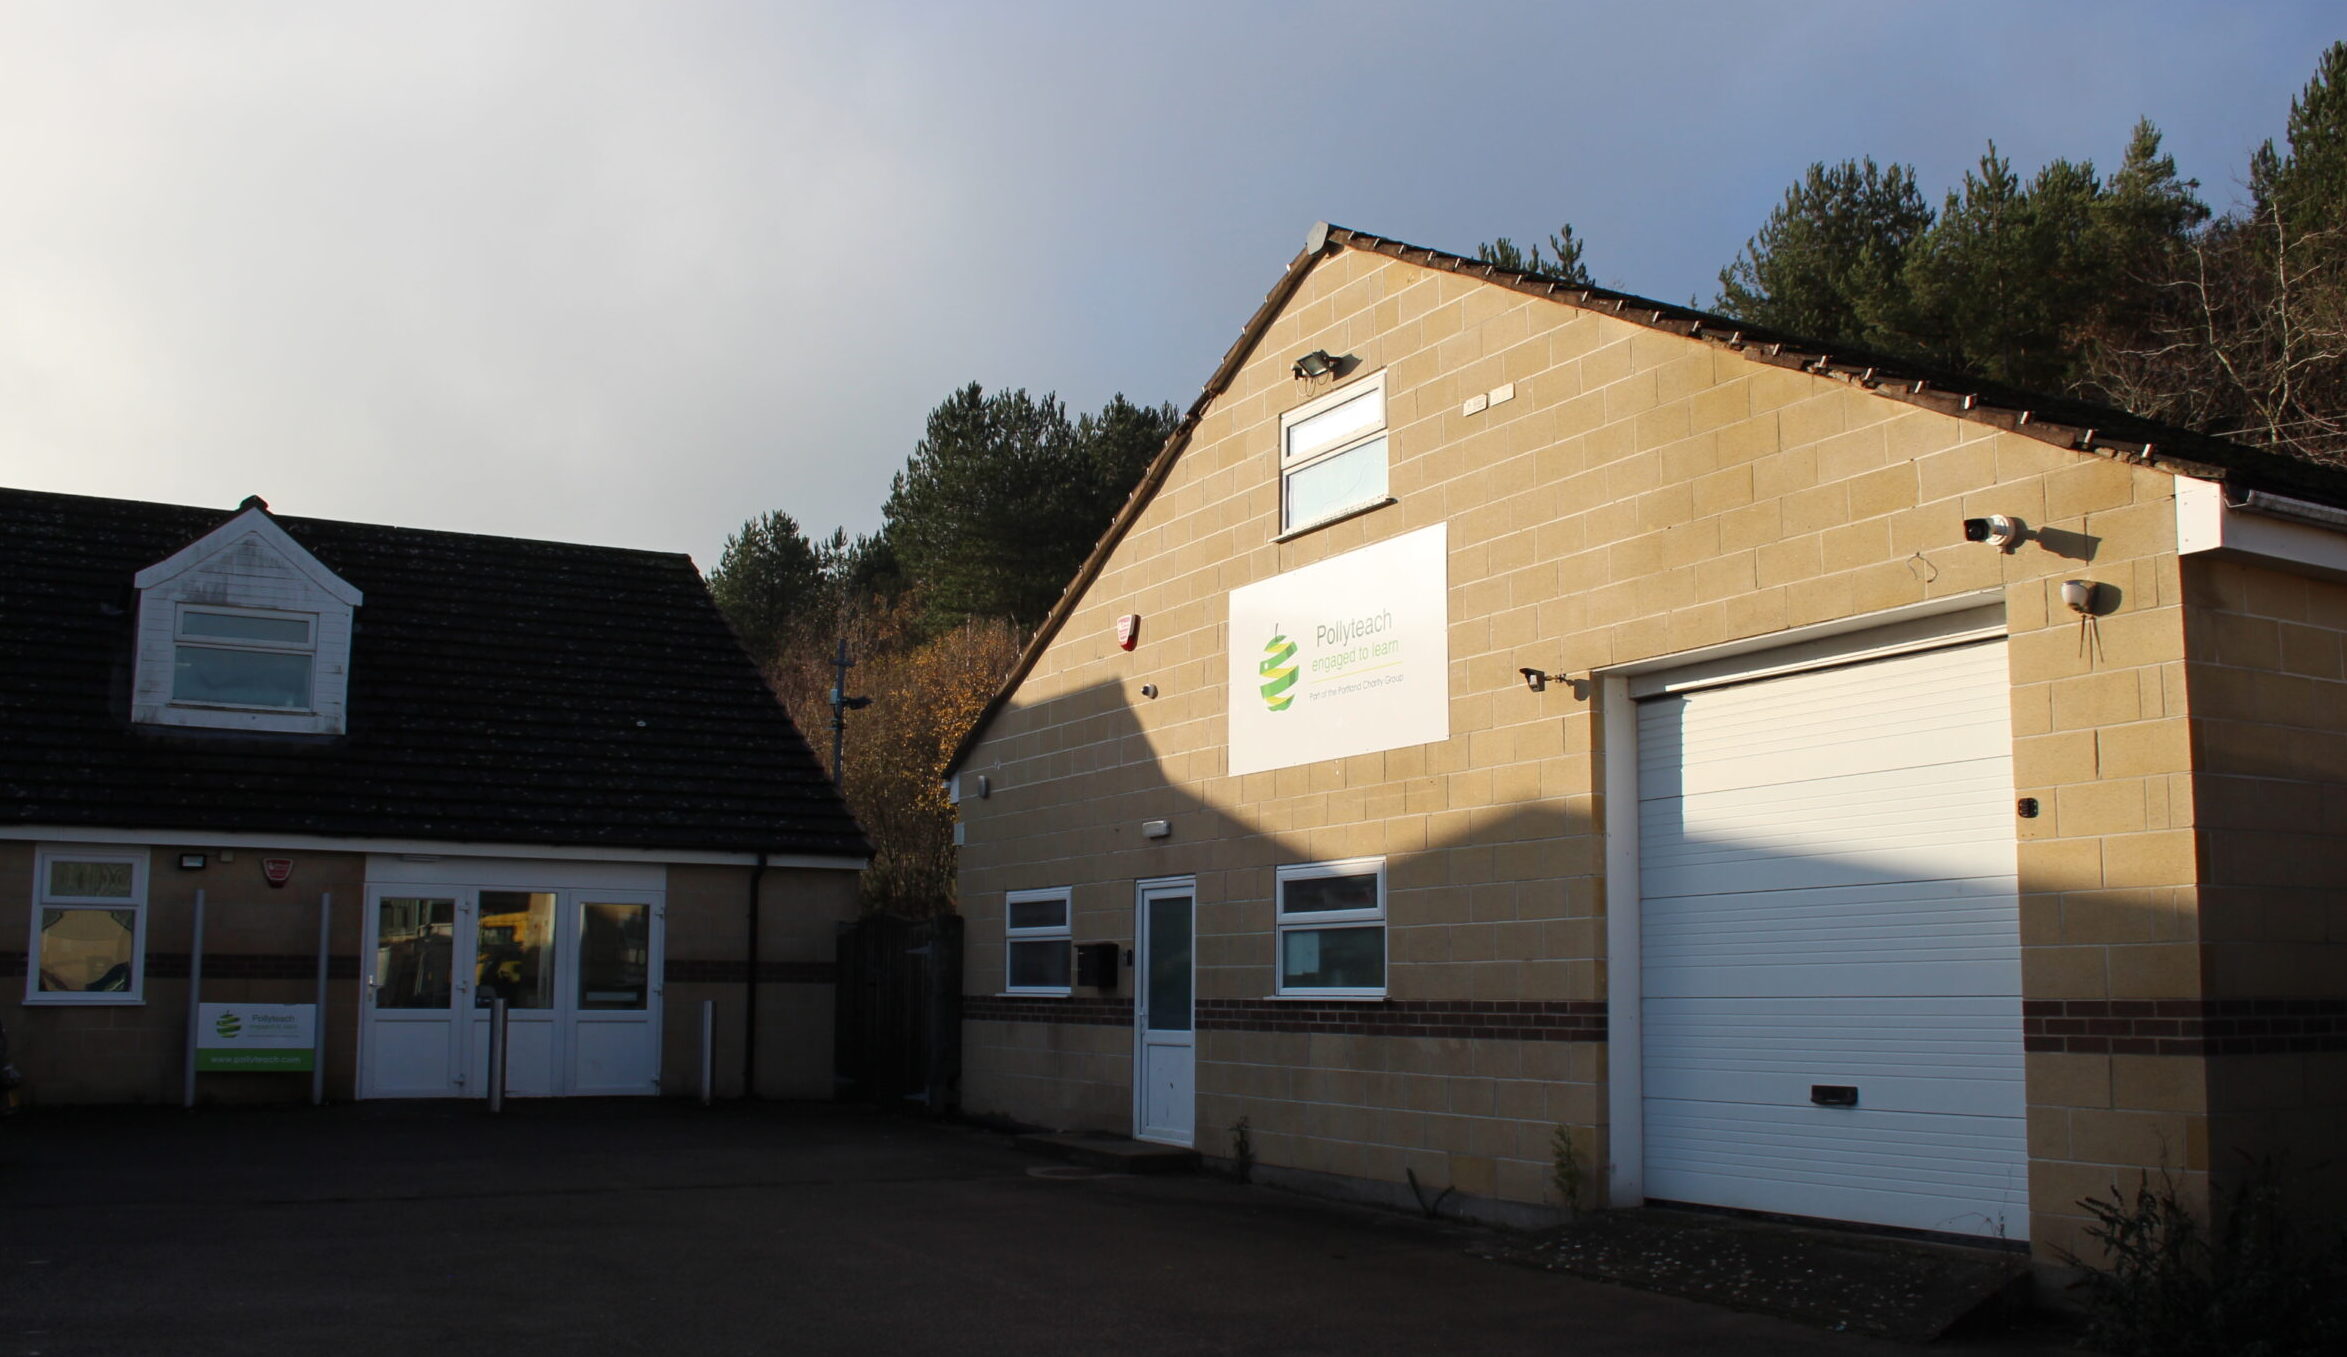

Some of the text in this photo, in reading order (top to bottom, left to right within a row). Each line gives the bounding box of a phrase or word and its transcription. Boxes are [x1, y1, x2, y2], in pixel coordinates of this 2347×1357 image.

[1317, 608, 1392, 647] Pollyteach
[1311, 639, 1399, 673] engaged to learn
[1328, 687, 1337, 697] the
[1363, 677, 1383, 691] Charity
[1385, 673, 1404, 685] Group
[252, 1014, 295, 1023] Pollyteach
